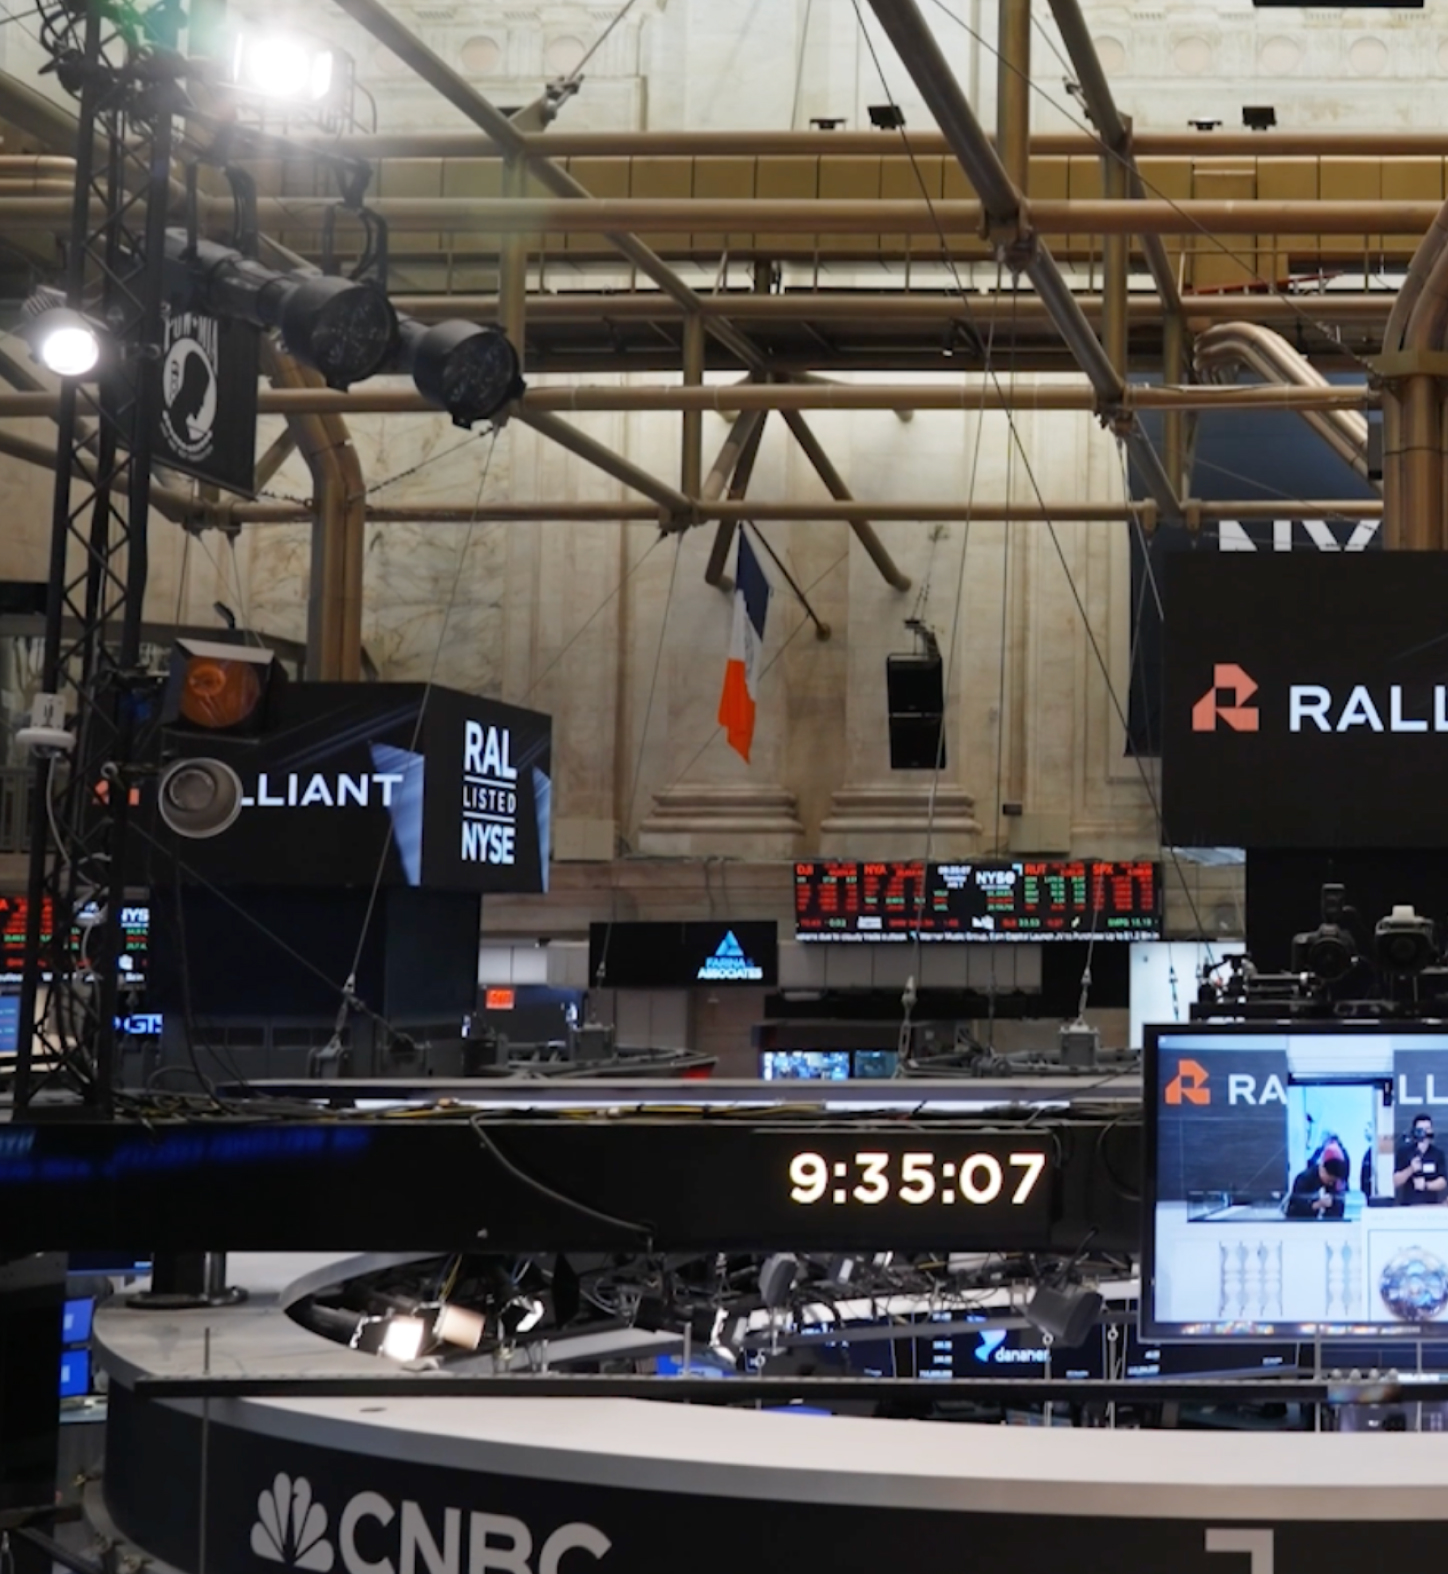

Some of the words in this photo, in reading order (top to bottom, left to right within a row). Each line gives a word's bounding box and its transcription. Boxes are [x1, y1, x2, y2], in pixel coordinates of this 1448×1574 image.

[464, 719, 518, 780] RAL
[462, 785, 517, 814] LISTED
[461, 820, 516, 865] NYSE
[864, 864, 887, 875] NYA
[1024, 863, 1047, 875] RUT
[1092, 863, 1114, 875] SPX
[697, 966, 764, 979] ASSOCIATES
[789, 1152, 1046, 1204] 9:35:07
